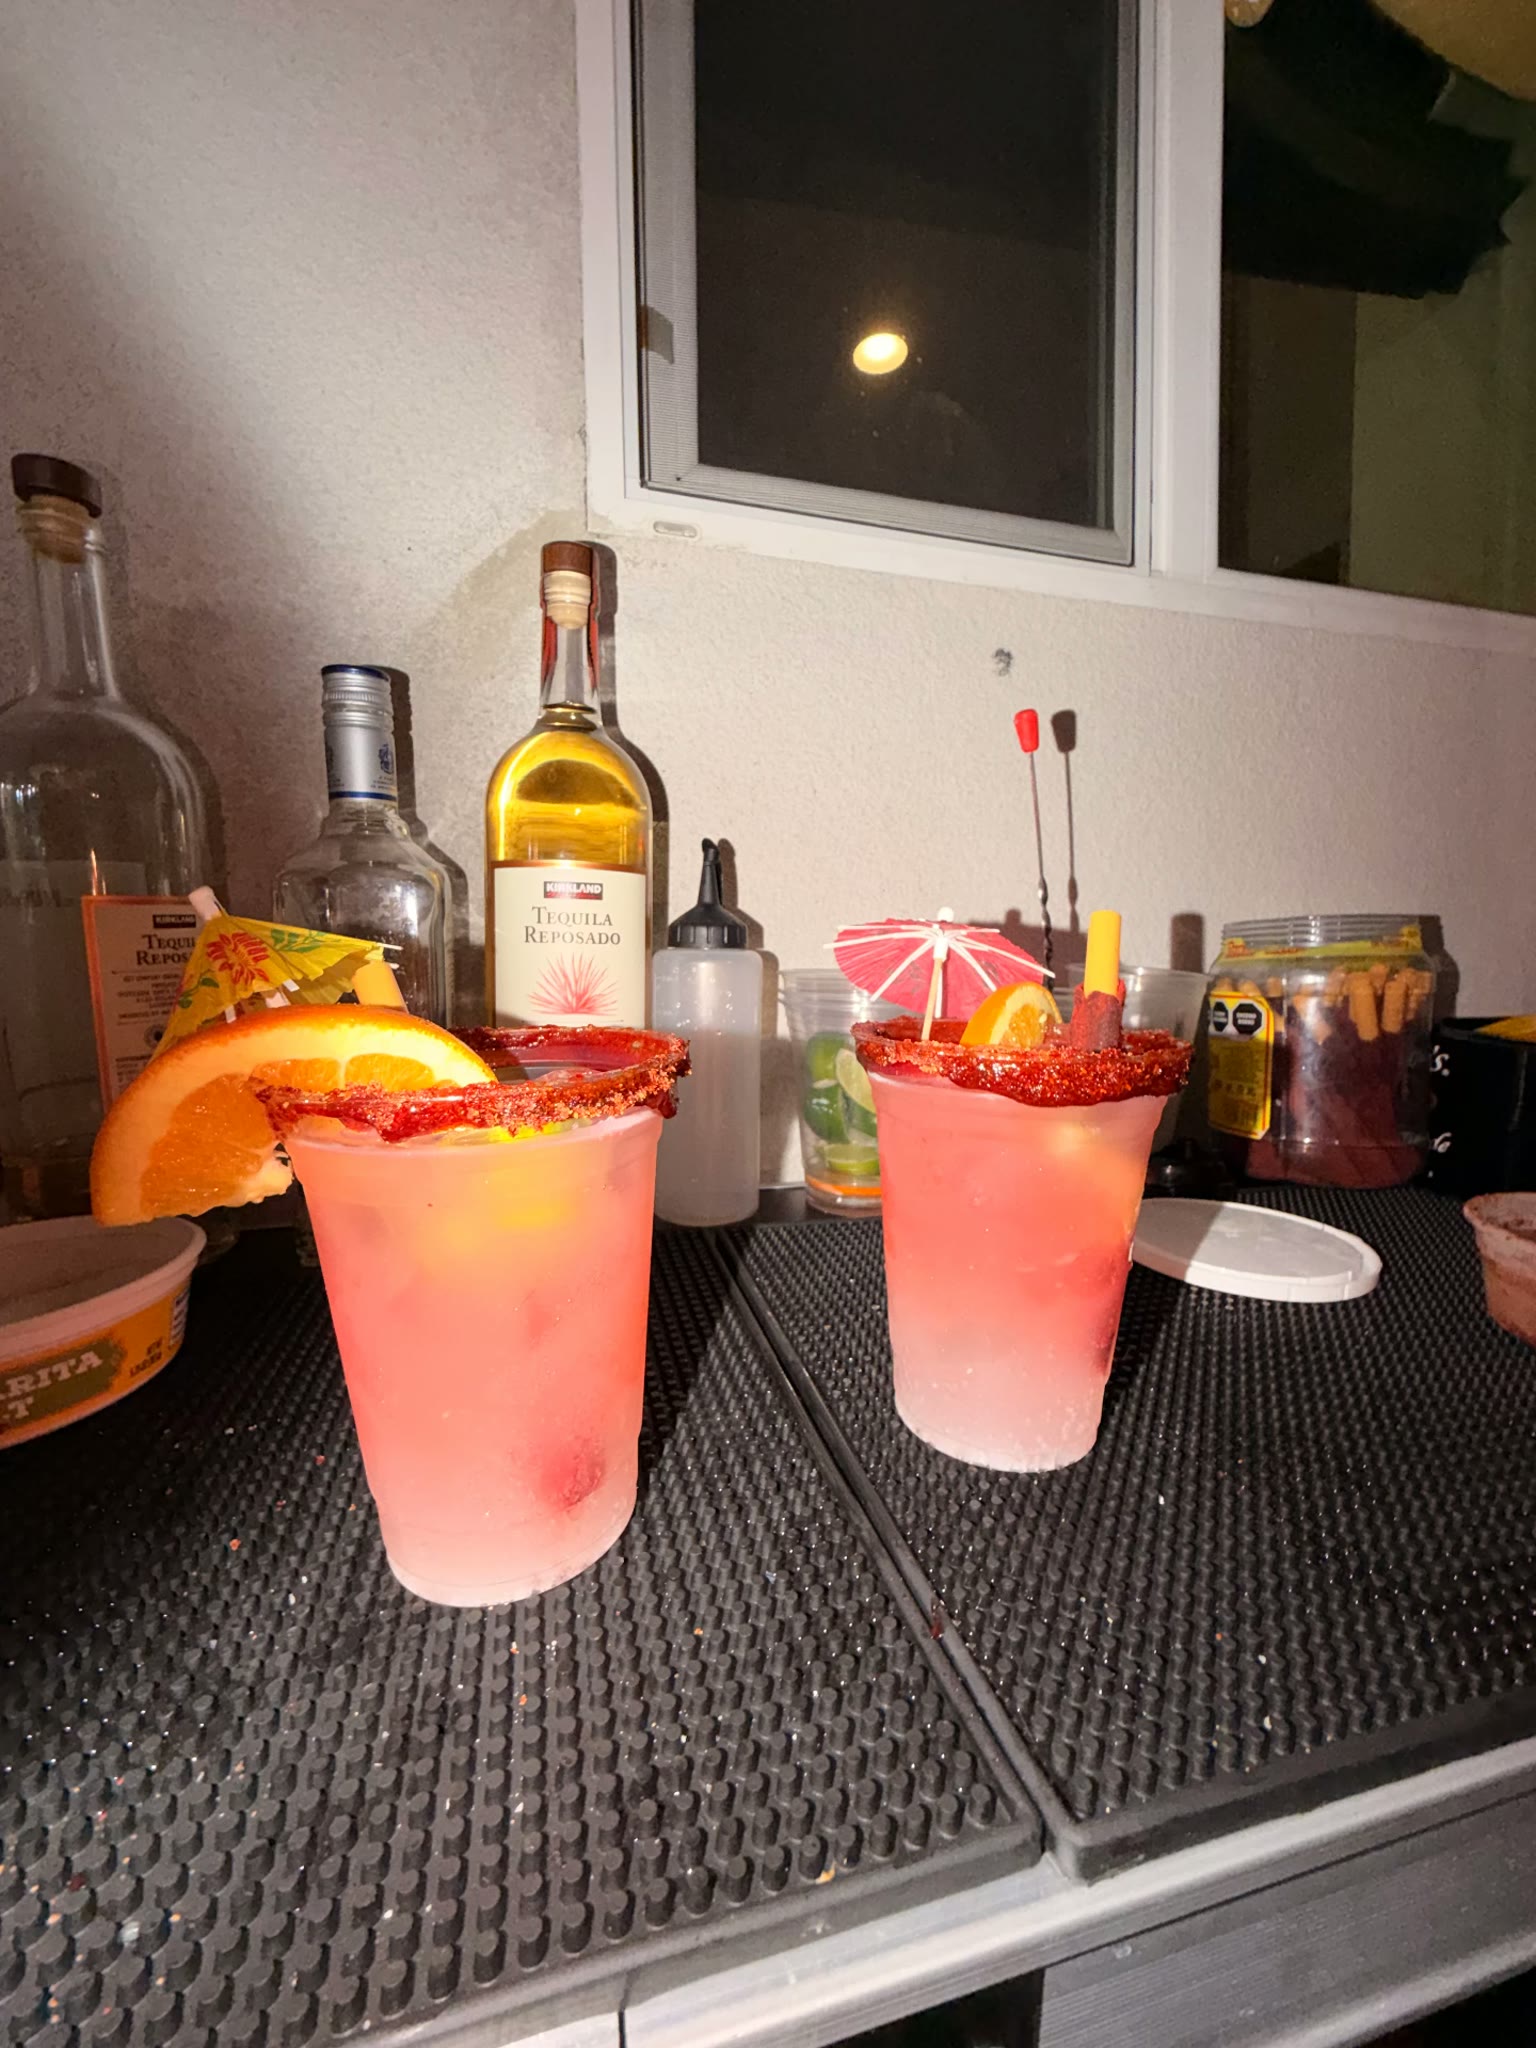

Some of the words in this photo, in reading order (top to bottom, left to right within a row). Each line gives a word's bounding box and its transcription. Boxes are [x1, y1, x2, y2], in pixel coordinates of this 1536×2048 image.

[546, 883, 602, 894] KIRKLAND
[532, 906, 613, 927] TEQUILA
[524, 925, 621, 945] REPOSADO
[136, 951, 190, 966] REPOS
[0, 1351, 102, 1400] RITA
